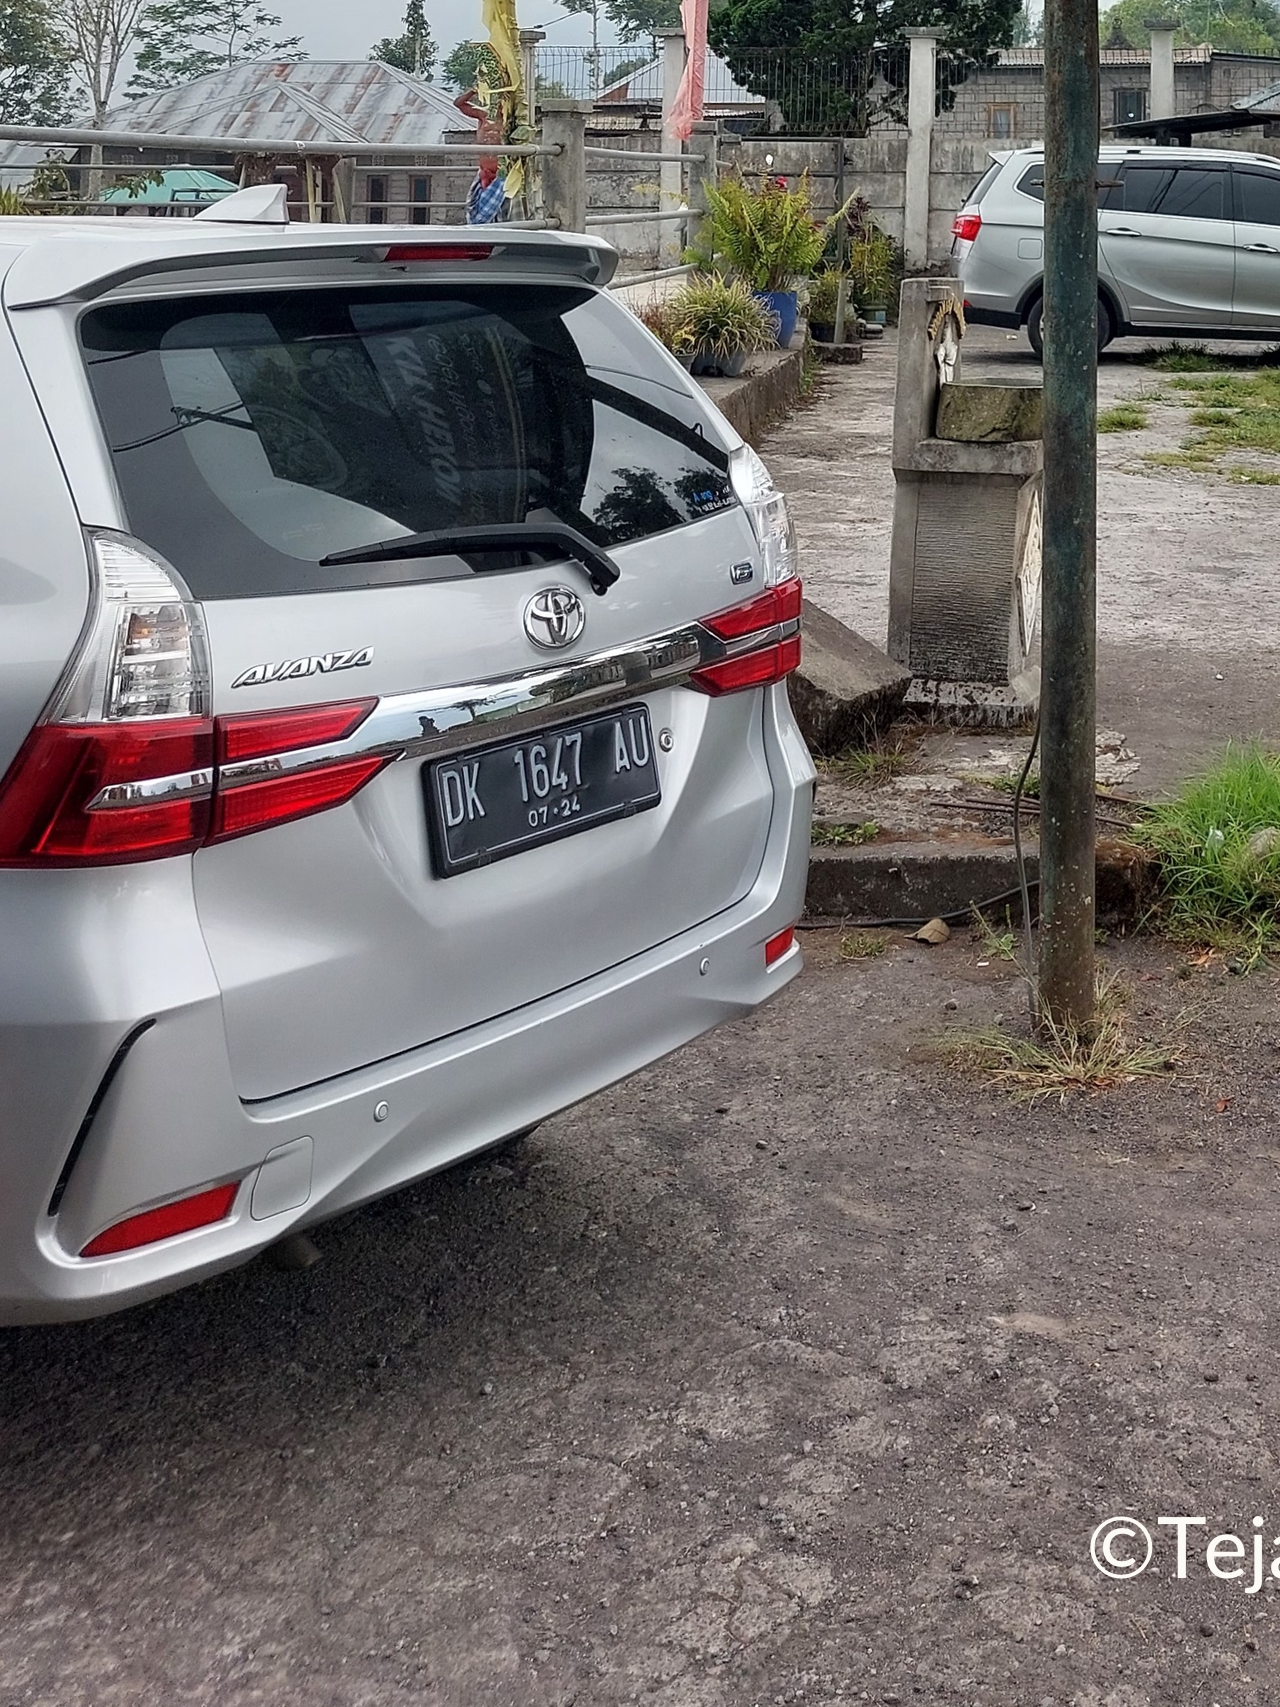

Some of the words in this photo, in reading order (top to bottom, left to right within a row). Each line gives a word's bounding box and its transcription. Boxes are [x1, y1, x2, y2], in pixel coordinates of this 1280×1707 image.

[231, 646, 375, 689] AVANZA
[442, 761, 486, 827] DK
[513, 731, 583, 803] 1647
[614, 715, 650, 774] AU
